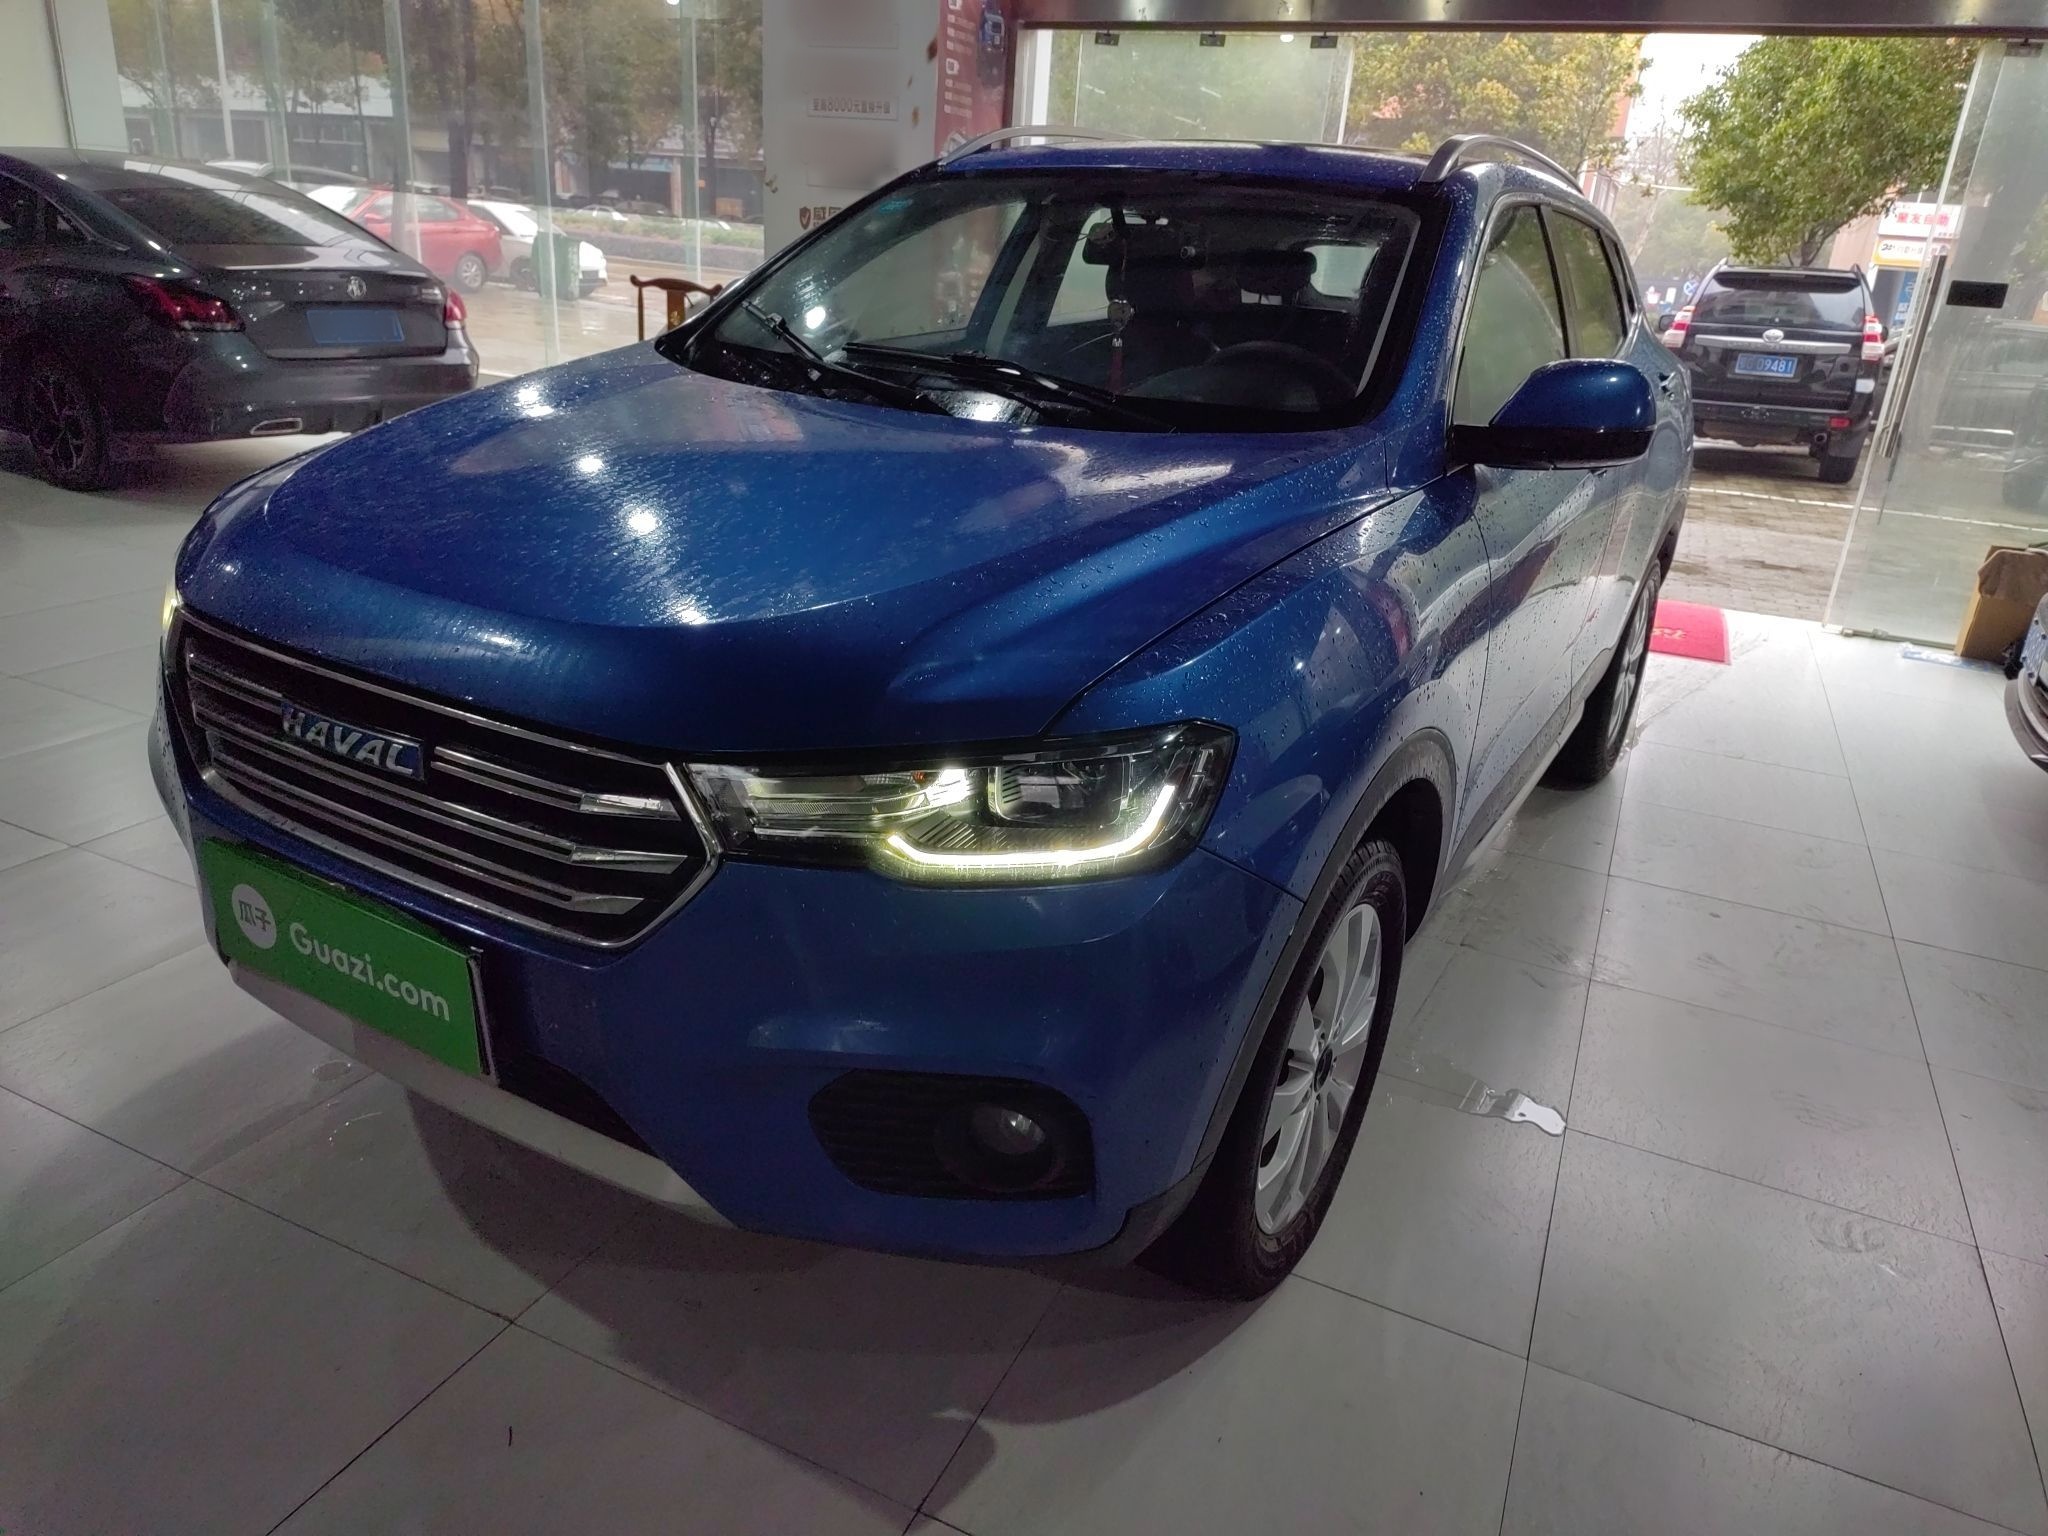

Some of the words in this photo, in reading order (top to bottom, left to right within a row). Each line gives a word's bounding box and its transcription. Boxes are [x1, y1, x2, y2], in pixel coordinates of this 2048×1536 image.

[282, 707, 414, 776] HAVAL
[238, 899, 272, 933] 瓜子
[289, 921, 450, 1021] Guazi.com
